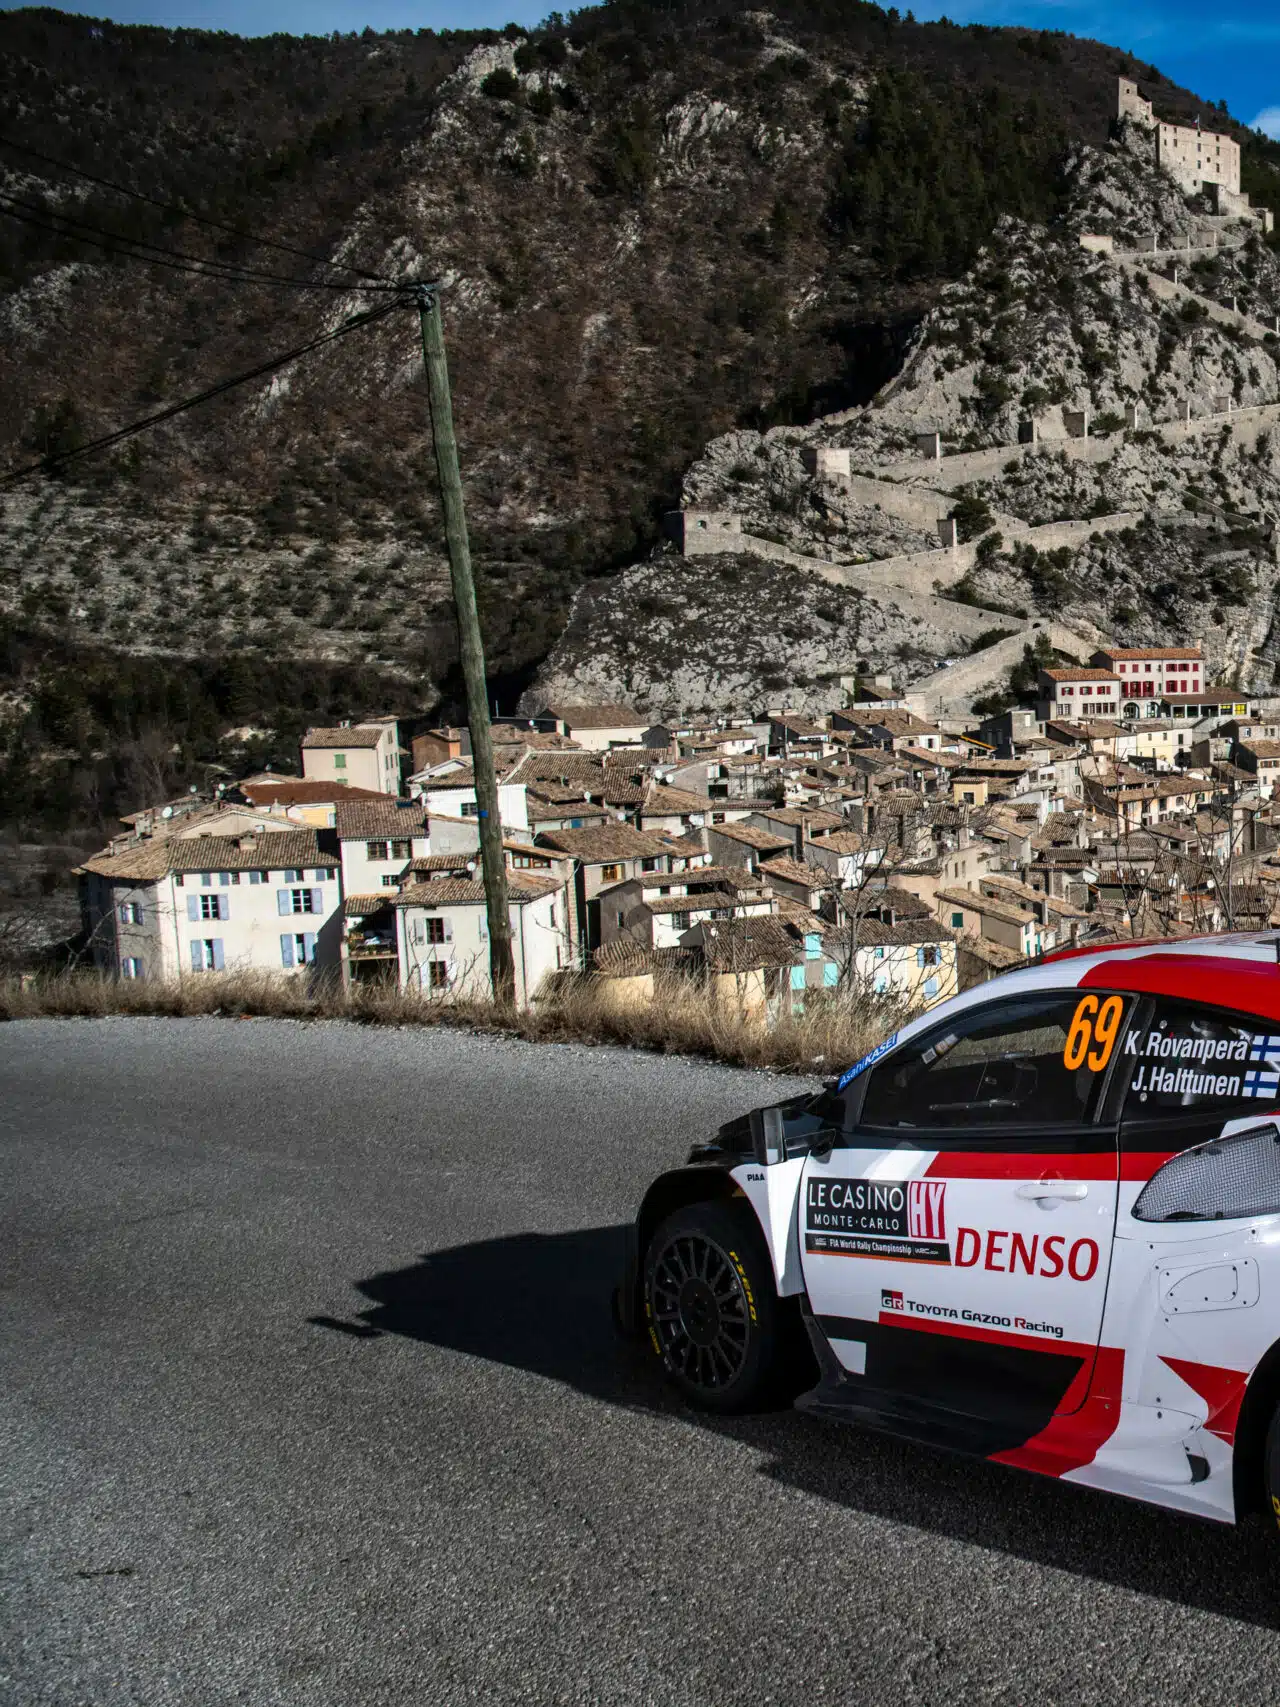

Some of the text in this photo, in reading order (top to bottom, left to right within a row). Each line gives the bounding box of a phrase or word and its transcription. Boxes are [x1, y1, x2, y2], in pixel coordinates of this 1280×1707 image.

[1063, 994, 1124, 1072] 69
[747, 1173, 765, 1181] PIAA
[809, 1183, 904, 1212] LE CASINO
[911, 1182, 945, 1238] HY
[829, 1238, 839, 1248] FIA
[840, 1239, 856, 1250] World
[857, 1240, 872, 1253] Rally
[872, 1242, 912, 1256] Championship
[954, 1227, 1100, 1282] DENSO
[882, 1296, 1064, 1338] GR TOYOTA GAZOO Racing
